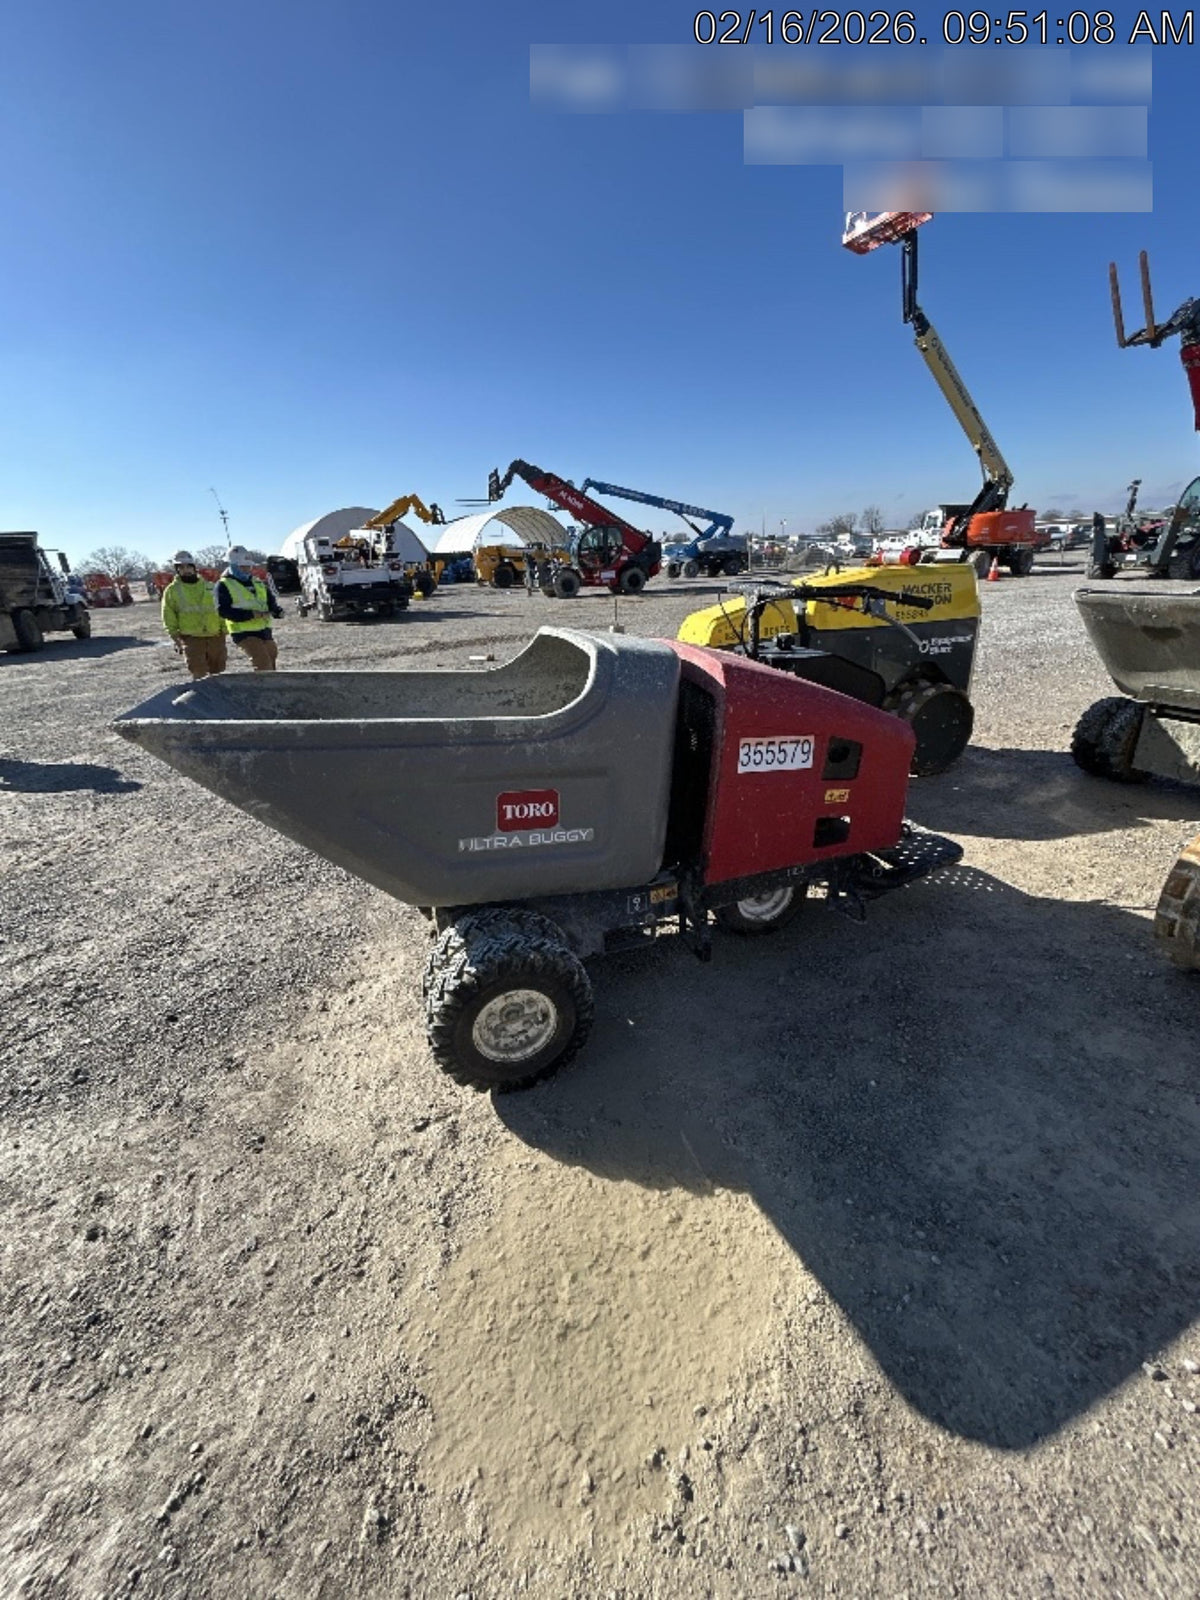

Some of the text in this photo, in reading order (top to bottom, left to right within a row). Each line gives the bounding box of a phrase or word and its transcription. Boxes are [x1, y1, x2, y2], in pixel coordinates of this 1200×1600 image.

[902, 582, 952, 595] WACKER
[740, 739, 812, 767] 355579
[503, 801, 555, 820] TORO
[529, 829, 590, 846] BUGGY
